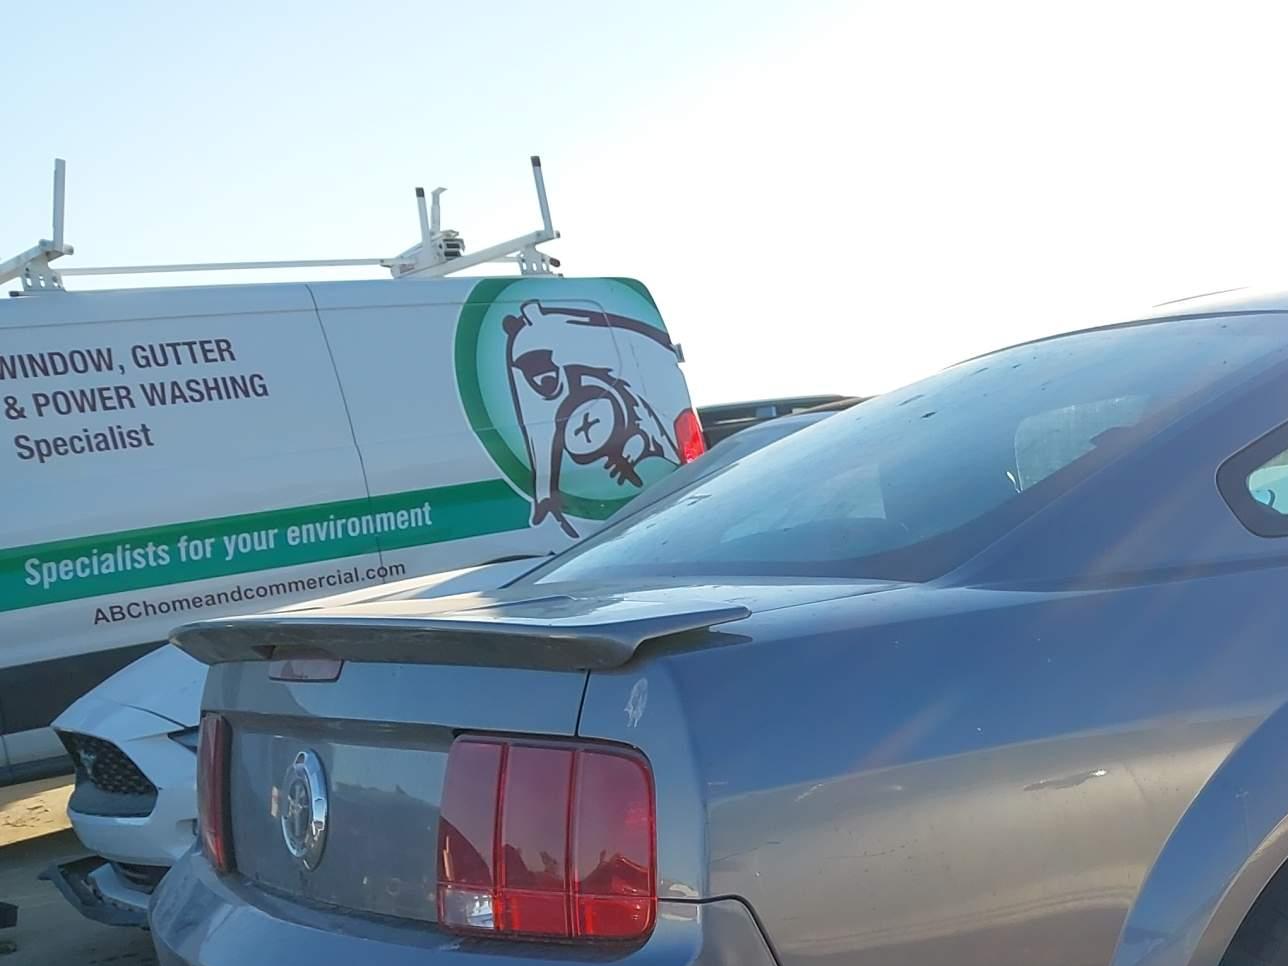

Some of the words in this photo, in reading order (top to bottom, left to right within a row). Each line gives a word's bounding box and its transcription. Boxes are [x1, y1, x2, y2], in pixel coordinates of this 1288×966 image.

[0, 347, 126, 380] WINDOW,
[131, 338, 236, 369] GUTTER
[4, 395, 27, 420] &
[32, 385, 136, 417] POWER
[140, 373, 269, 407] WASHING
[14, 423, 155, 464] Specialist
[24, 542, 171, 589] Specialists
[177, 535, 216, 563] for
[223, 528, 279, 561] your
[286, 501, 433, 546] environment
[93, 562, 406, 625] ABChomeandcommercial.com
